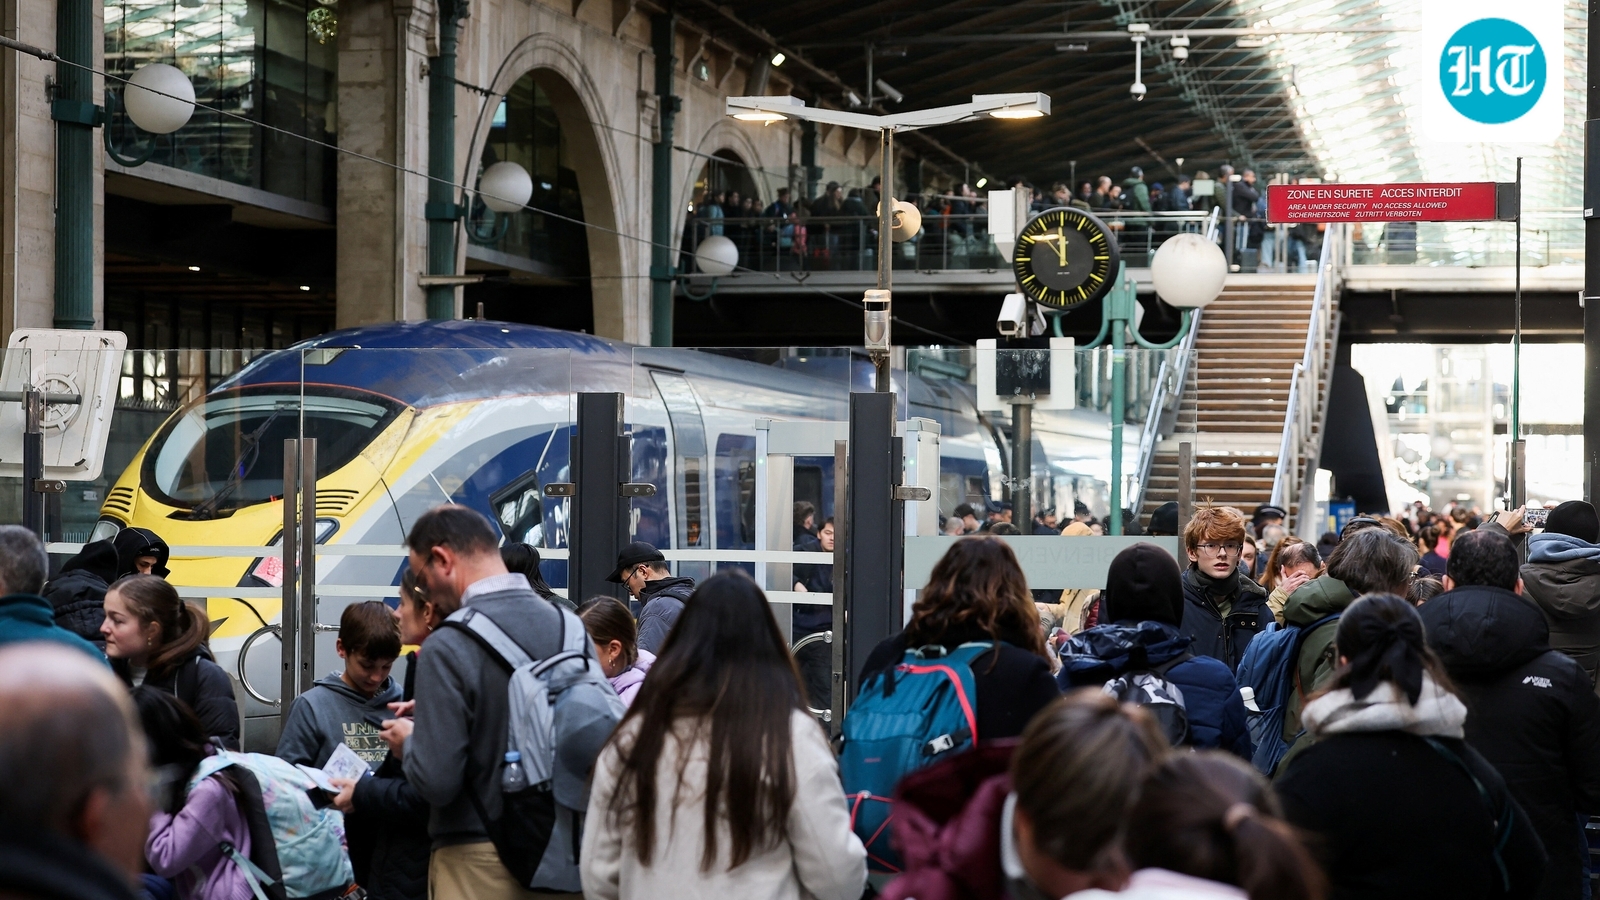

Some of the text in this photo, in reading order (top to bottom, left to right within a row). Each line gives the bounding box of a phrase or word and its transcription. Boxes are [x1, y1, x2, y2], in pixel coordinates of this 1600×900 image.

[1287, 188, 1462, 199] ZONE EN SURETE ACCES INTERDIT
